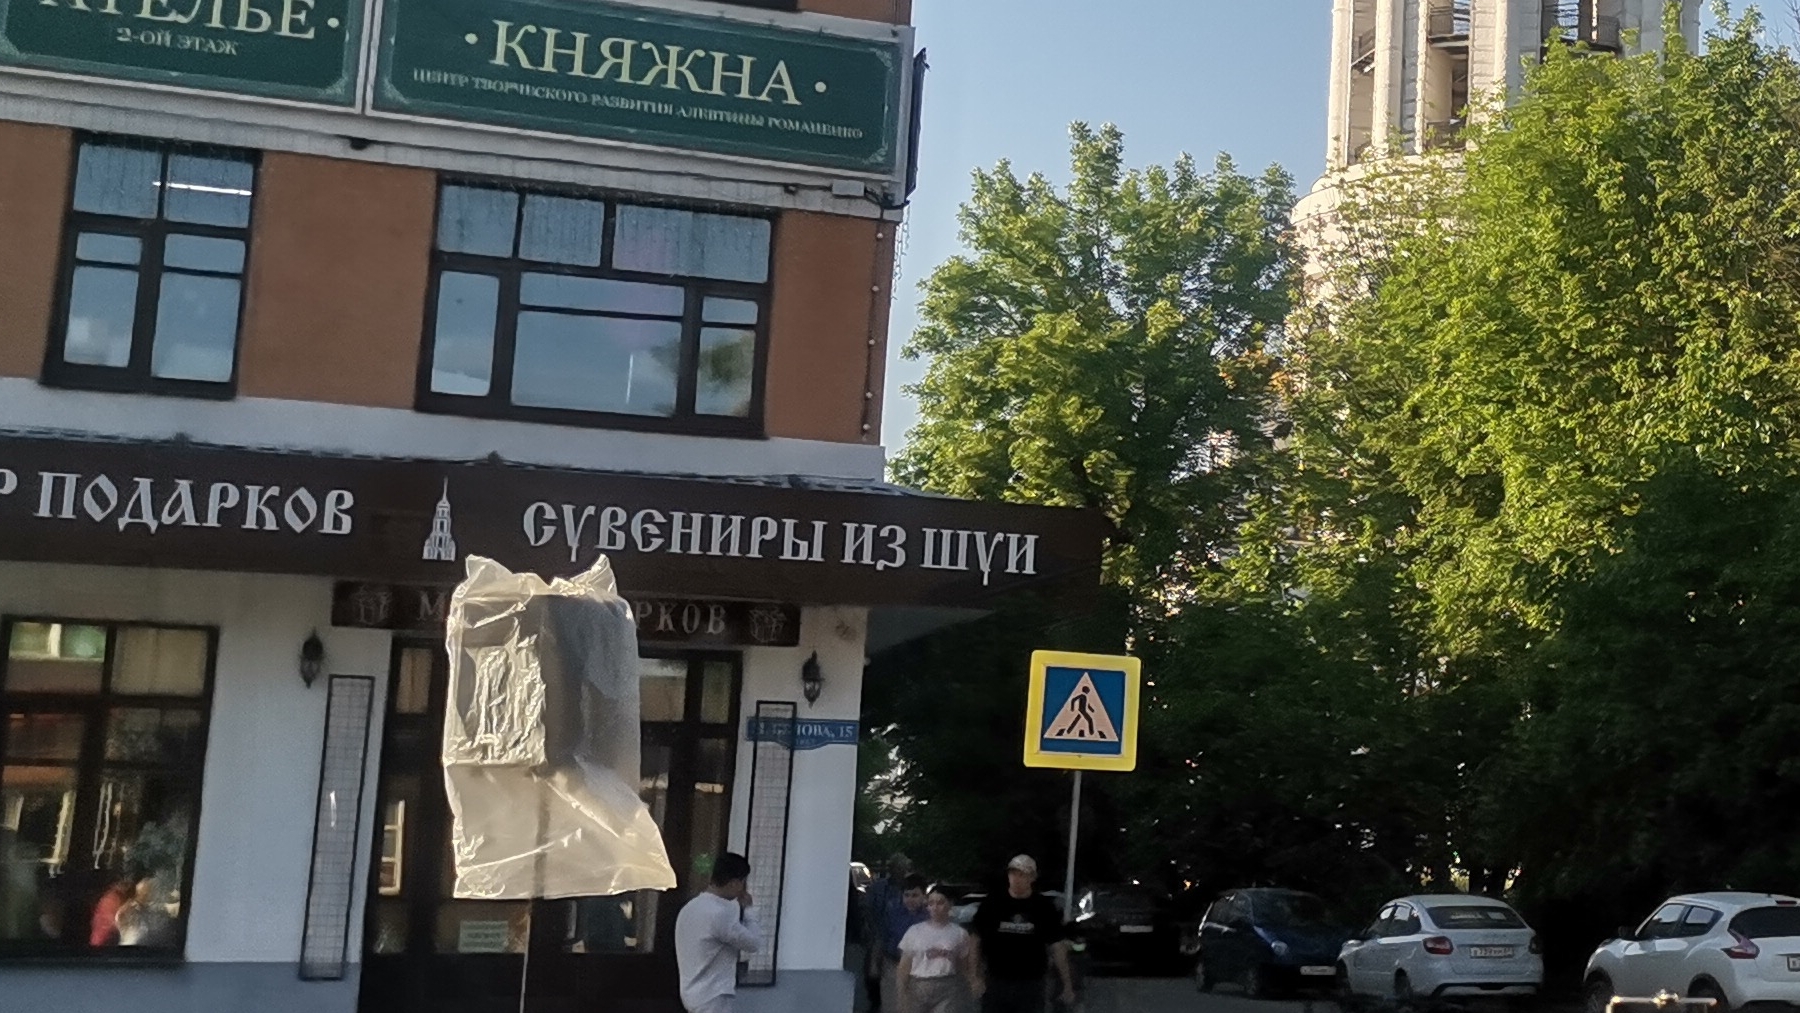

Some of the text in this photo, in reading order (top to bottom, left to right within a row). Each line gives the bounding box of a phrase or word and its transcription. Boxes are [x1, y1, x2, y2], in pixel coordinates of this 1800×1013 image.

[176, 31, 240, 56] ЭТАЖ
[489, 19, 802, 105] КНЯЖНА
[412, 67, 469, 88] ЦЕНТР
[471, 75, 589, 104] ТВОРЧЕСКОГО
[591, 93, 674, 116] РАЗВИТИЯ
[34, 471, 354, 536] ПОДАРКОВ
[522, 501, 1040, 586] СУВЕНИРЫ ИЗ ШУИ
